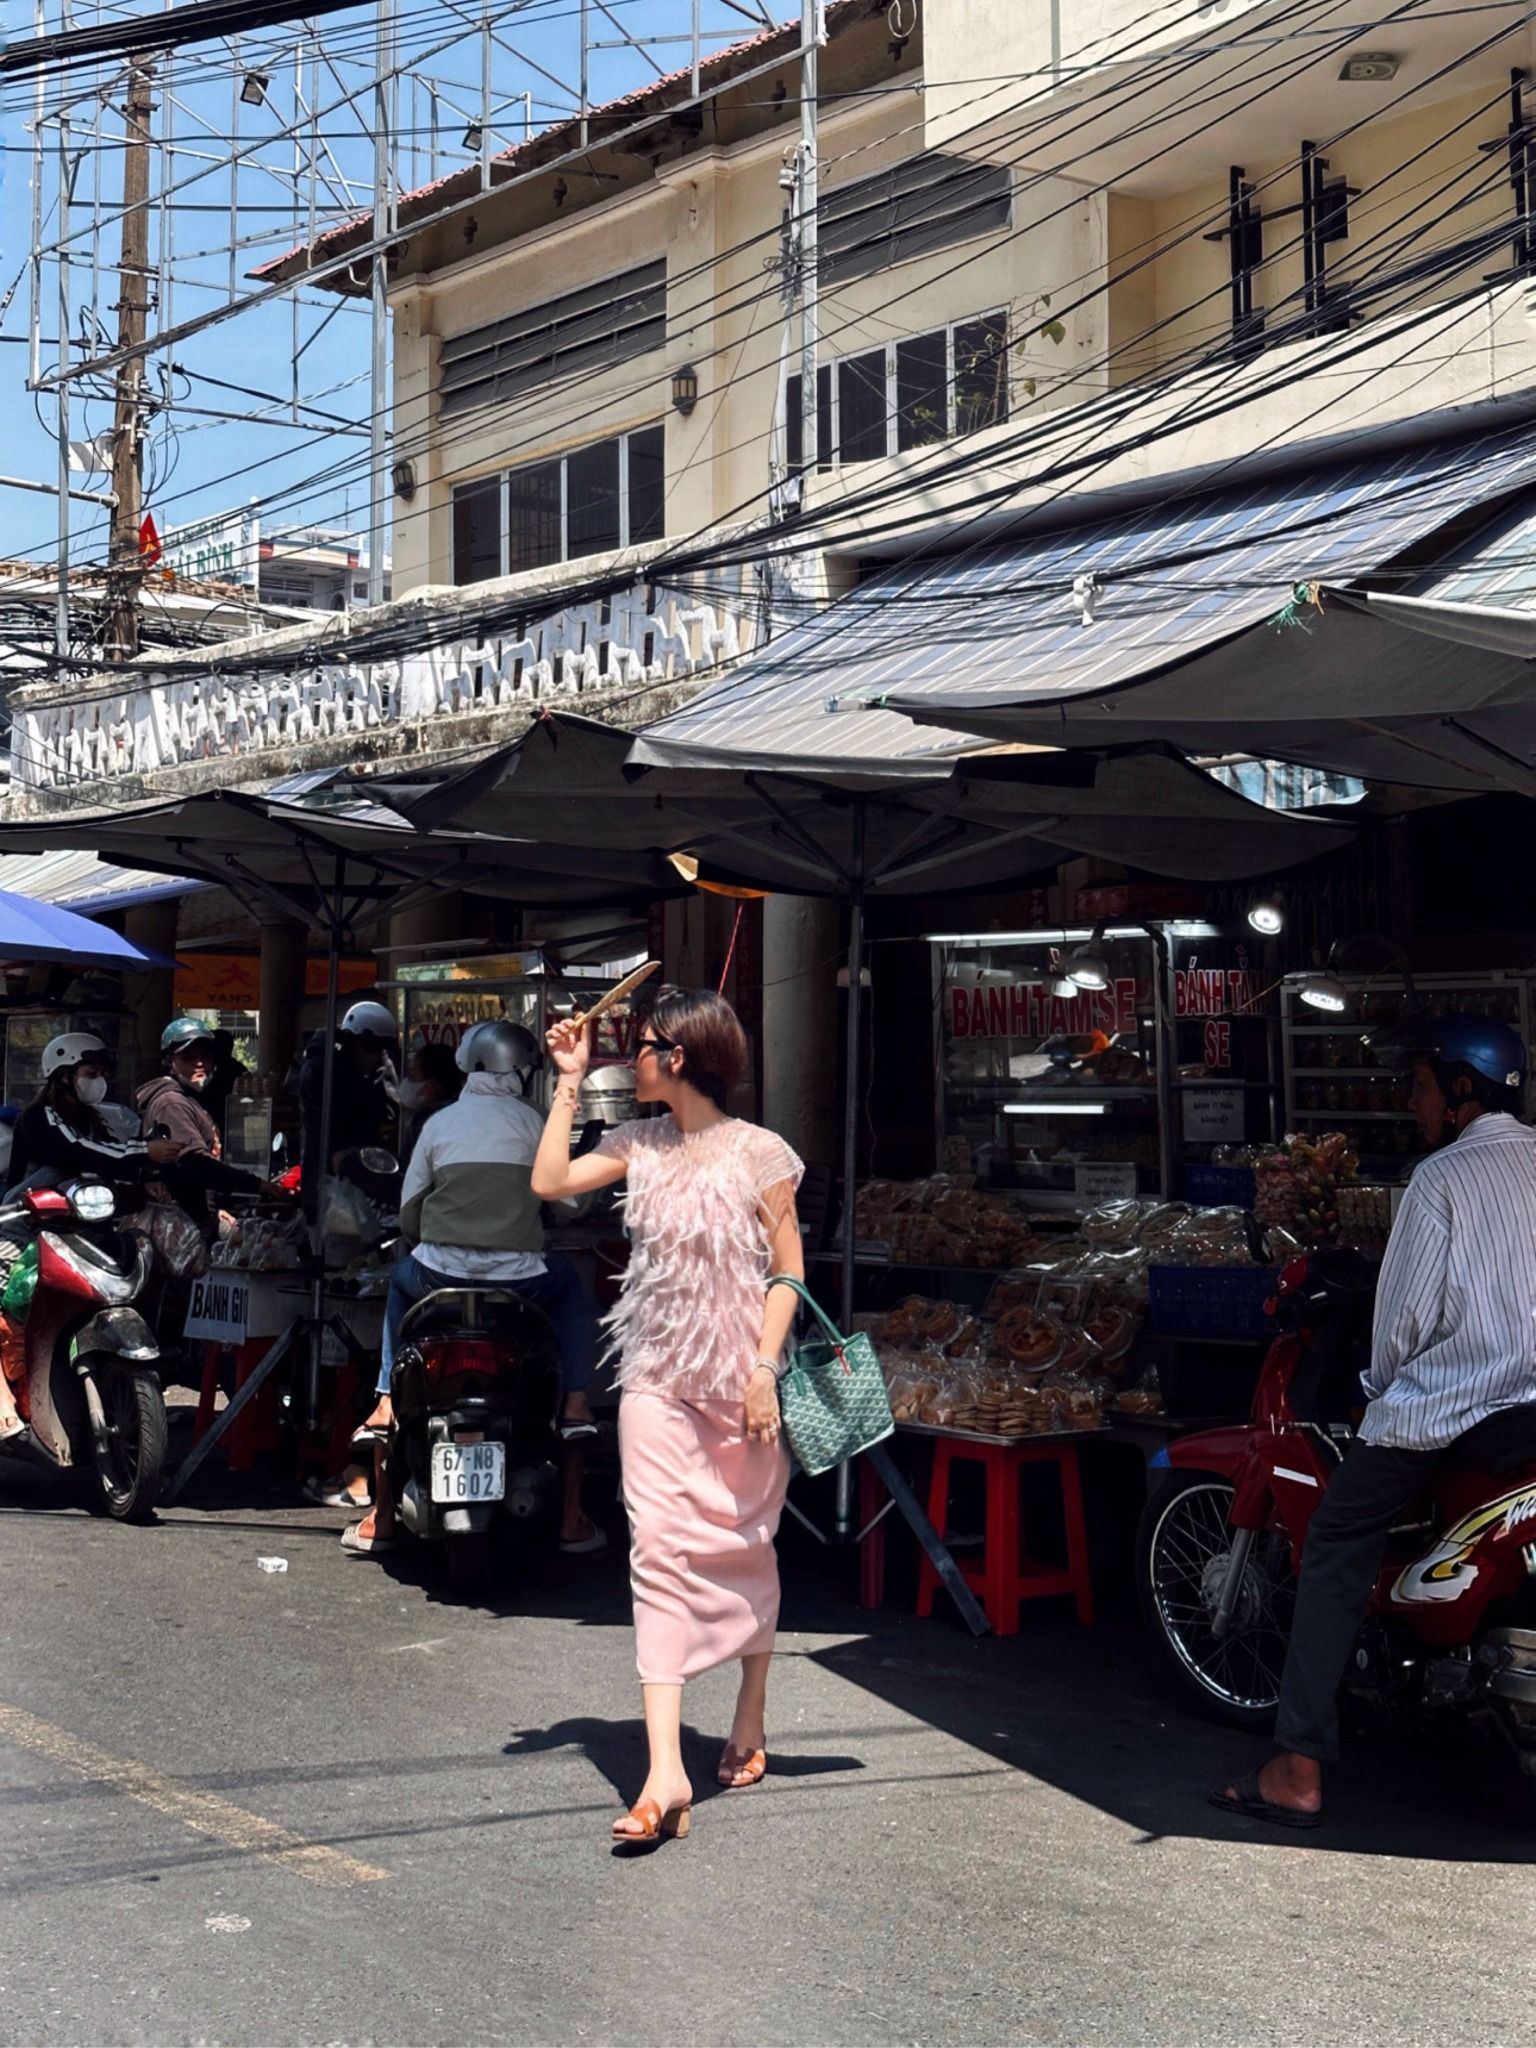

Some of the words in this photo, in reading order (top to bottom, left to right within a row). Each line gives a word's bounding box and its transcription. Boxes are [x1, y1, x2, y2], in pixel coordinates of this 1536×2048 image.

[952, 970, 1032, 1039] BÁNH
[1094, 977, 1137, 1036] SE
[1174, 955, 1224, 1016] BÁNH
[1204, 1020, 1231, 1068] SE
[191, 1275, 229, 1322] BÁNH
[443, 1447, 494, 1471] 67-N8
[443, 1473, 494, 1497] 1602
